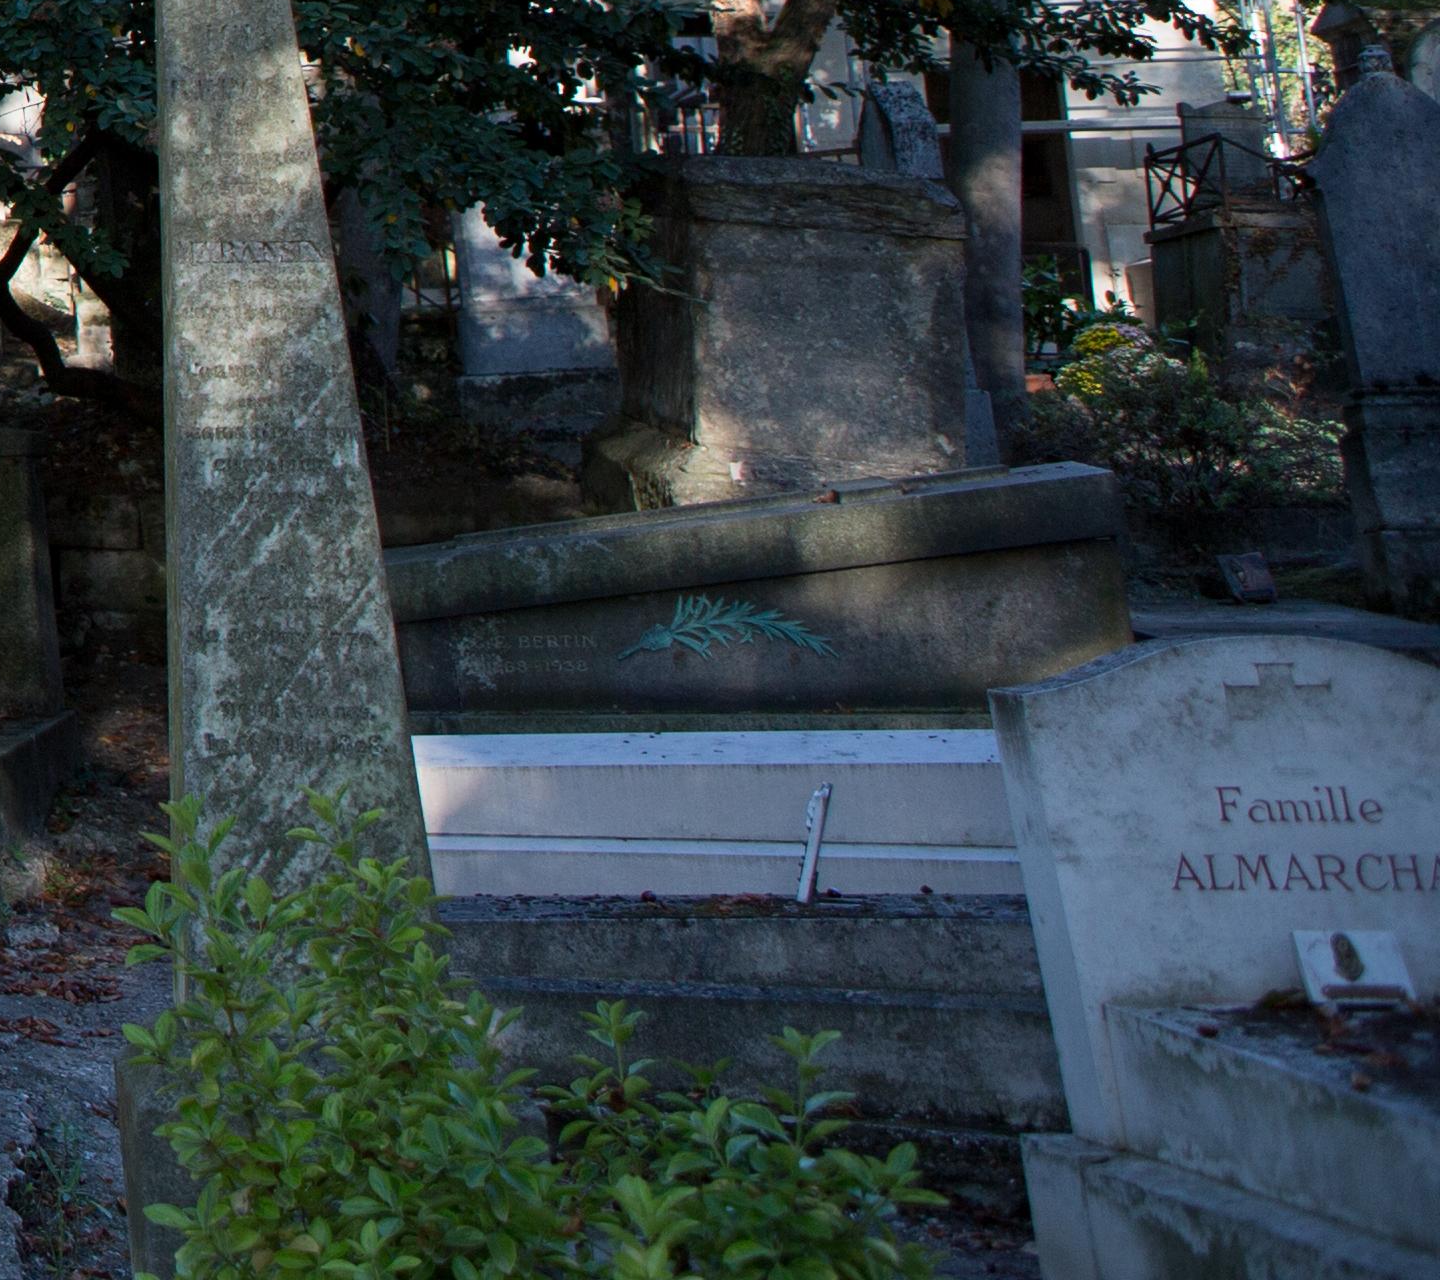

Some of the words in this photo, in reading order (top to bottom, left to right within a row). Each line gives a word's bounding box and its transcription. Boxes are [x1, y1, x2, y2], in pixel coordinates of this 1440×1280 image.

[518, 634, 598, 649] BERTIN
[1215, 785, 1384, 824] Famille
[1171, 851, 1440, 893] ALMARCH
